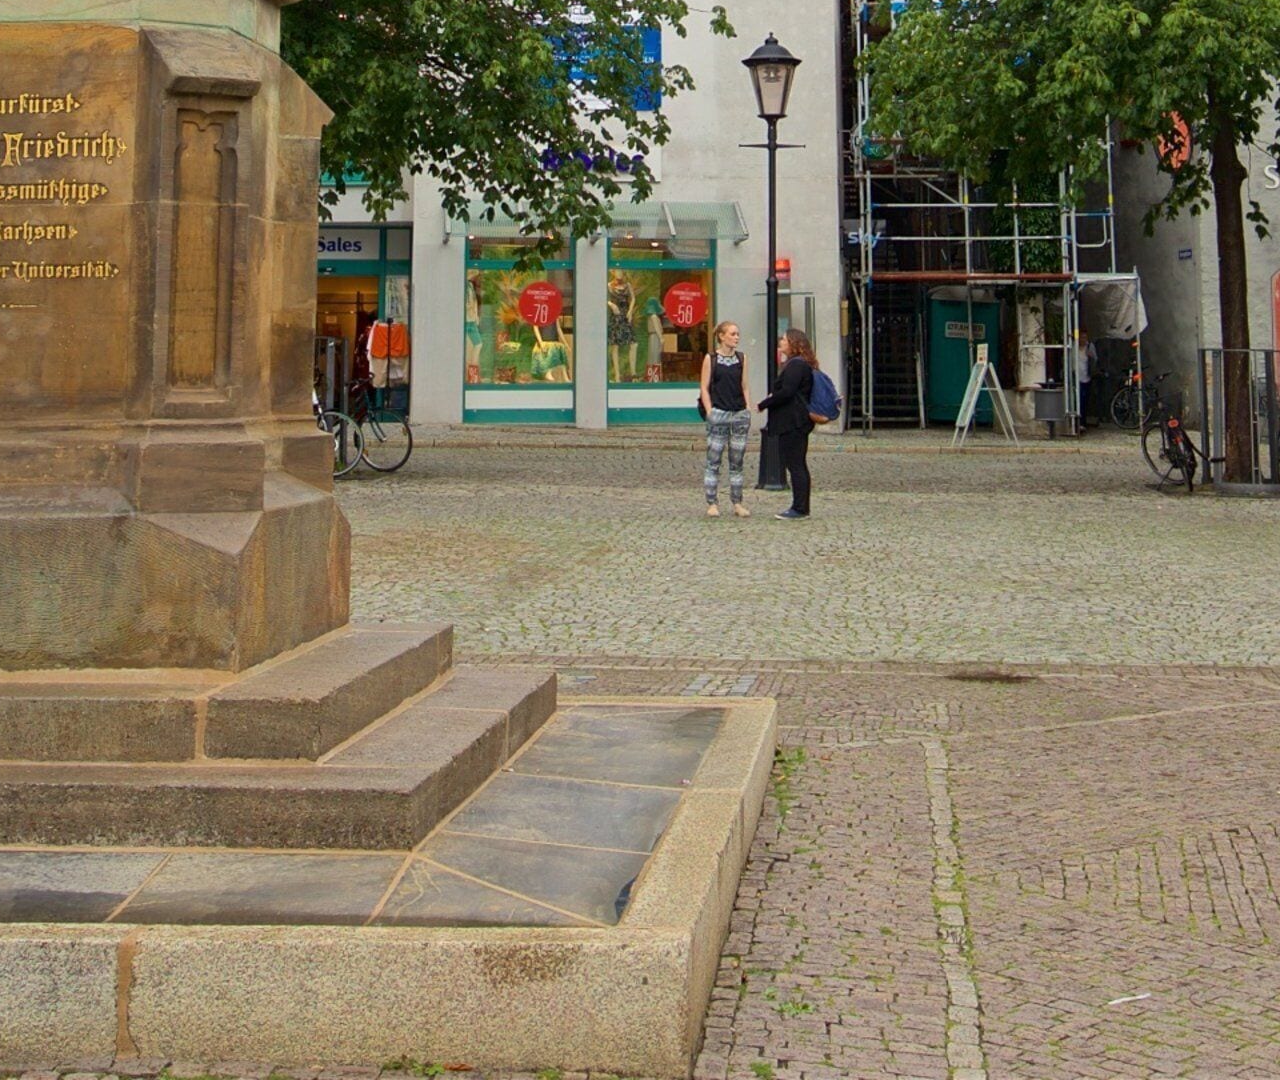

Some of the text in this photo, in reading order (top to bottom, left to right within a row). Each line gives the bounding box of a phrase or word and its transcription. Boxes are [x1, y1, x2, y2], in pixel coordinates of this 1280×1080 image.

[0, 130, 117, 169] Friedrich
[317, 237, 362, 252] Sales
[848, 227, 881, 248] sky
